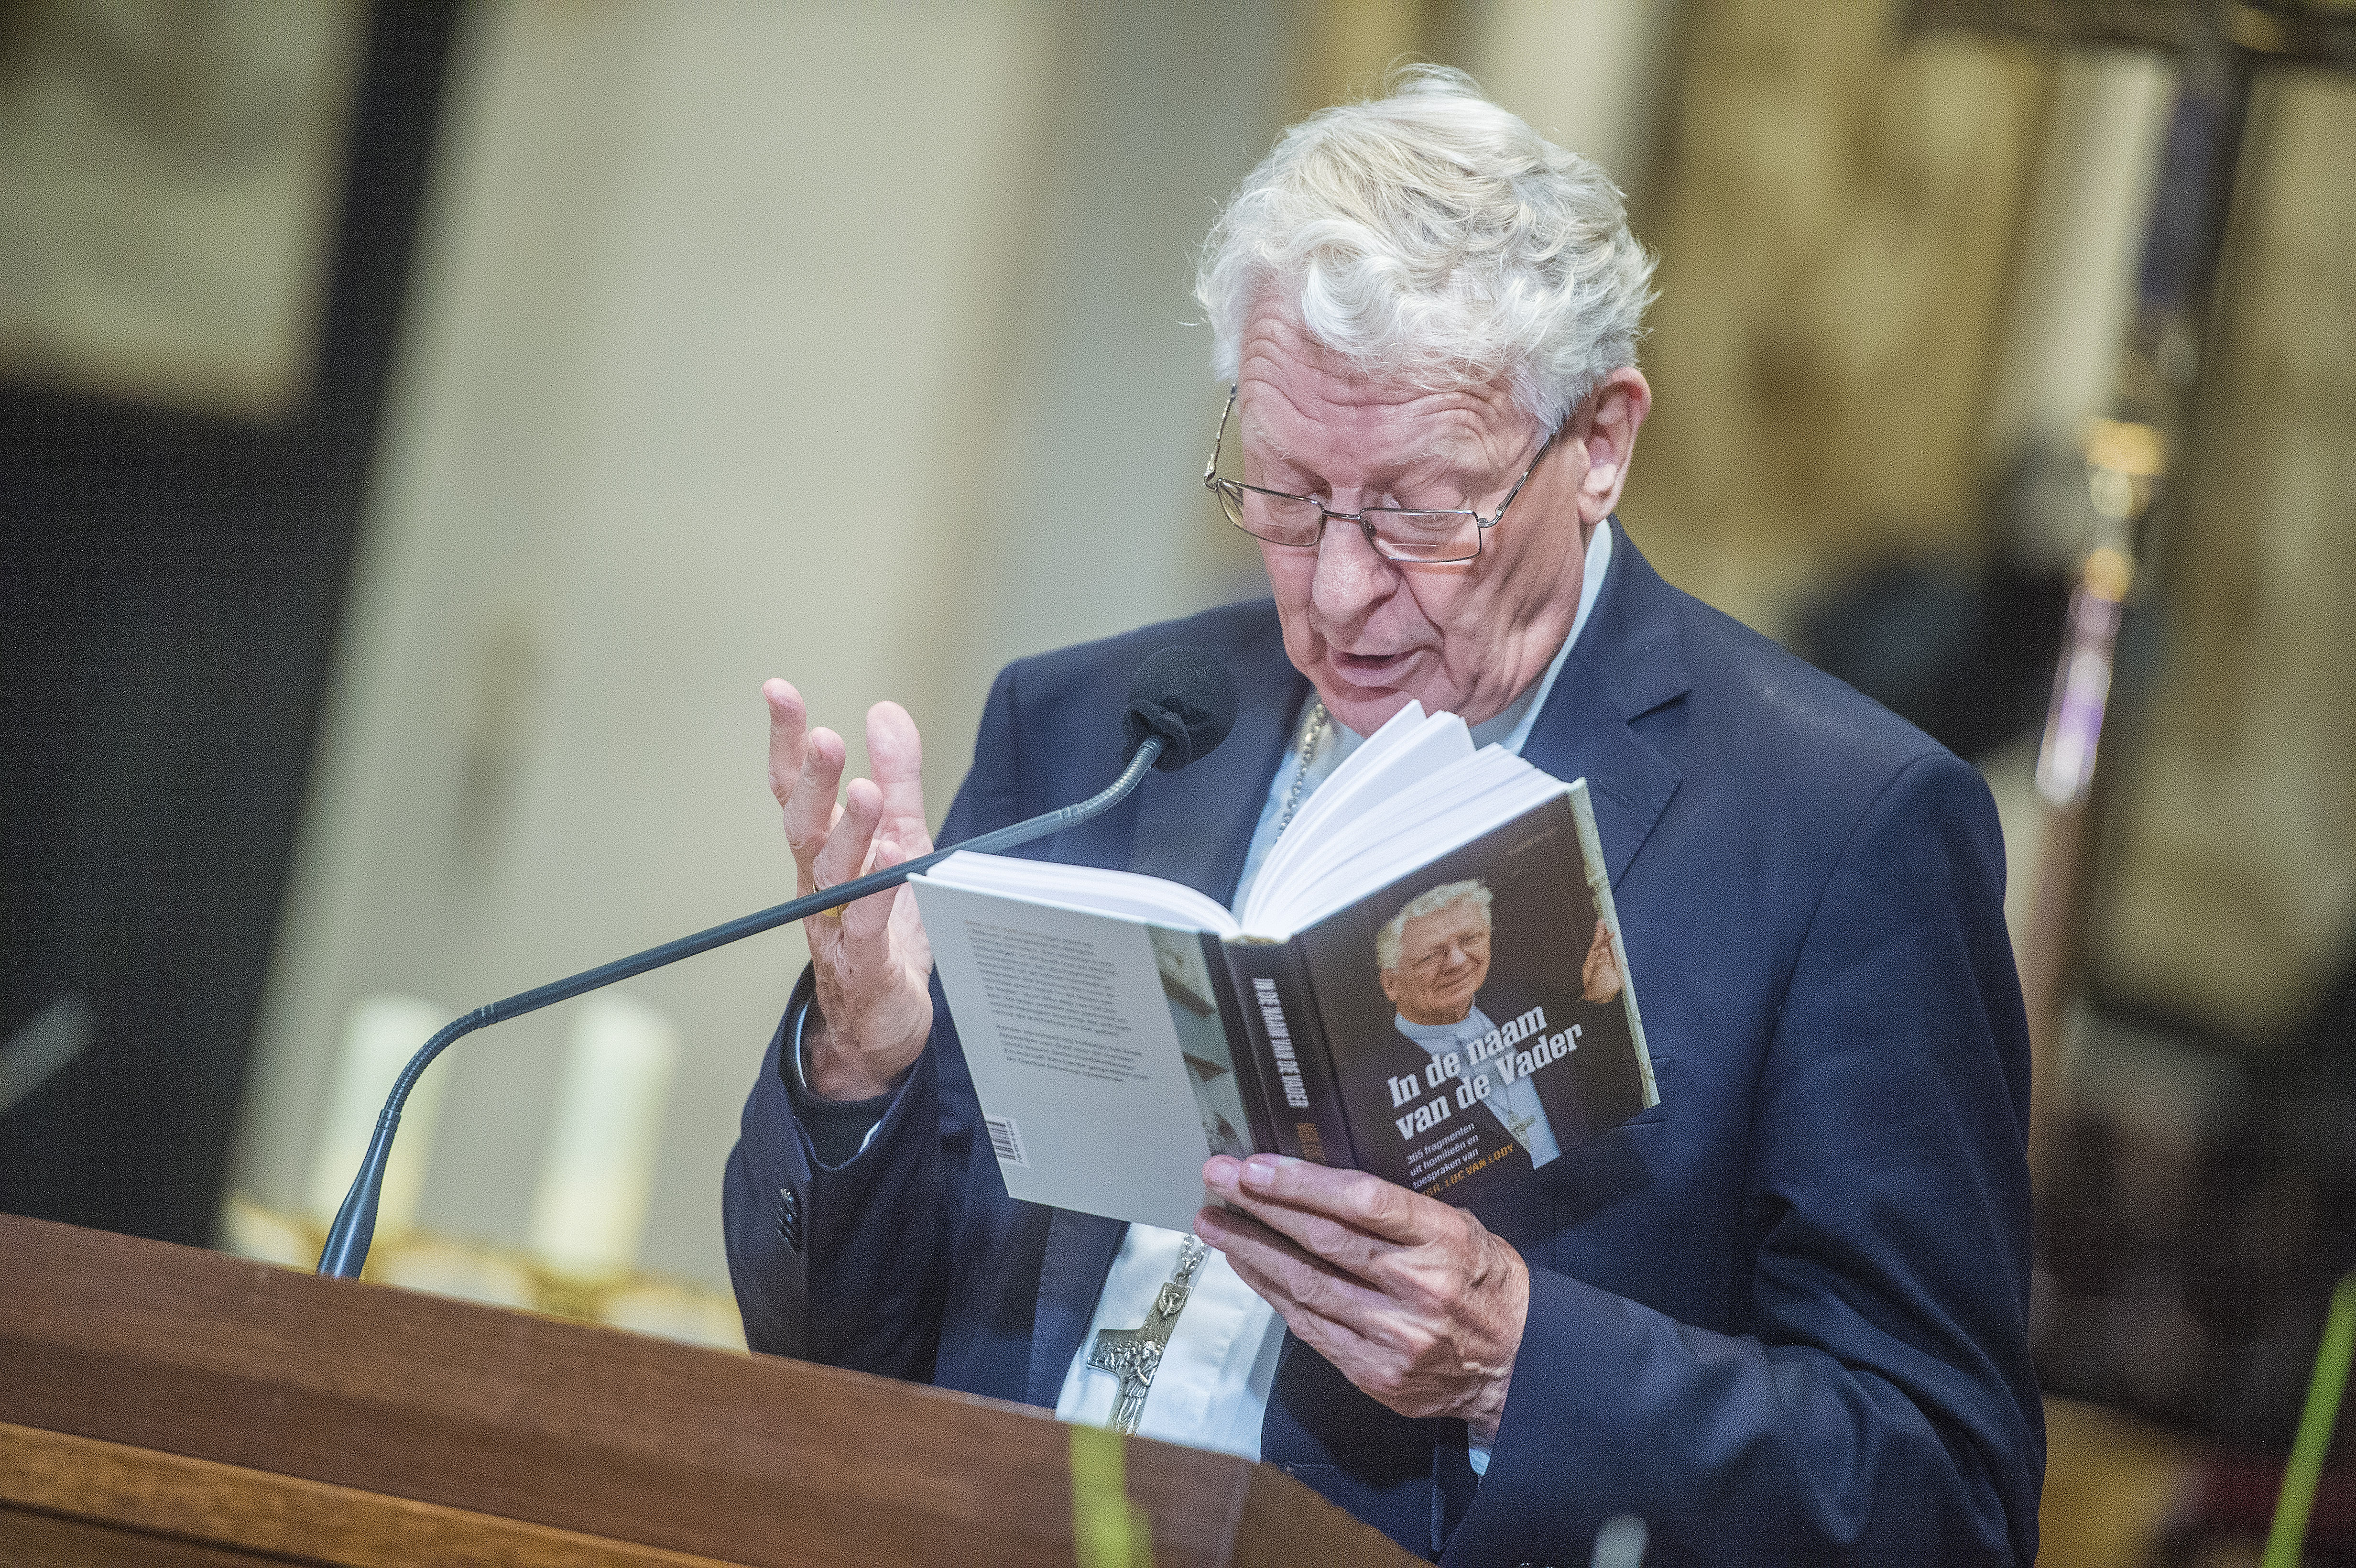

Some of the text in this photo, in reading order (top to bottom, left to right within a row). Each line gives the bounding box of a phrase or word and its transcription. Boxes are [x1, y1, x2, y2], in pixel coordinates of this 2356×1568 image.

[1387, 1006, 1548, 1108] In de naam
[1395, 1024, 1583, 1141] van de Vader
[1407, 1123, 1474, 1164] 365 fragmenten
[1410, 1134, 1479, 1177] uit homilieën en
[1445, 1171, 1465, 1187] LUC
[1465, 1158, 1486, 1176] VAN
[1488, 1143, 1513, 1164] LOOY
[1412, 1149, 1479, 1189] toespraken van
